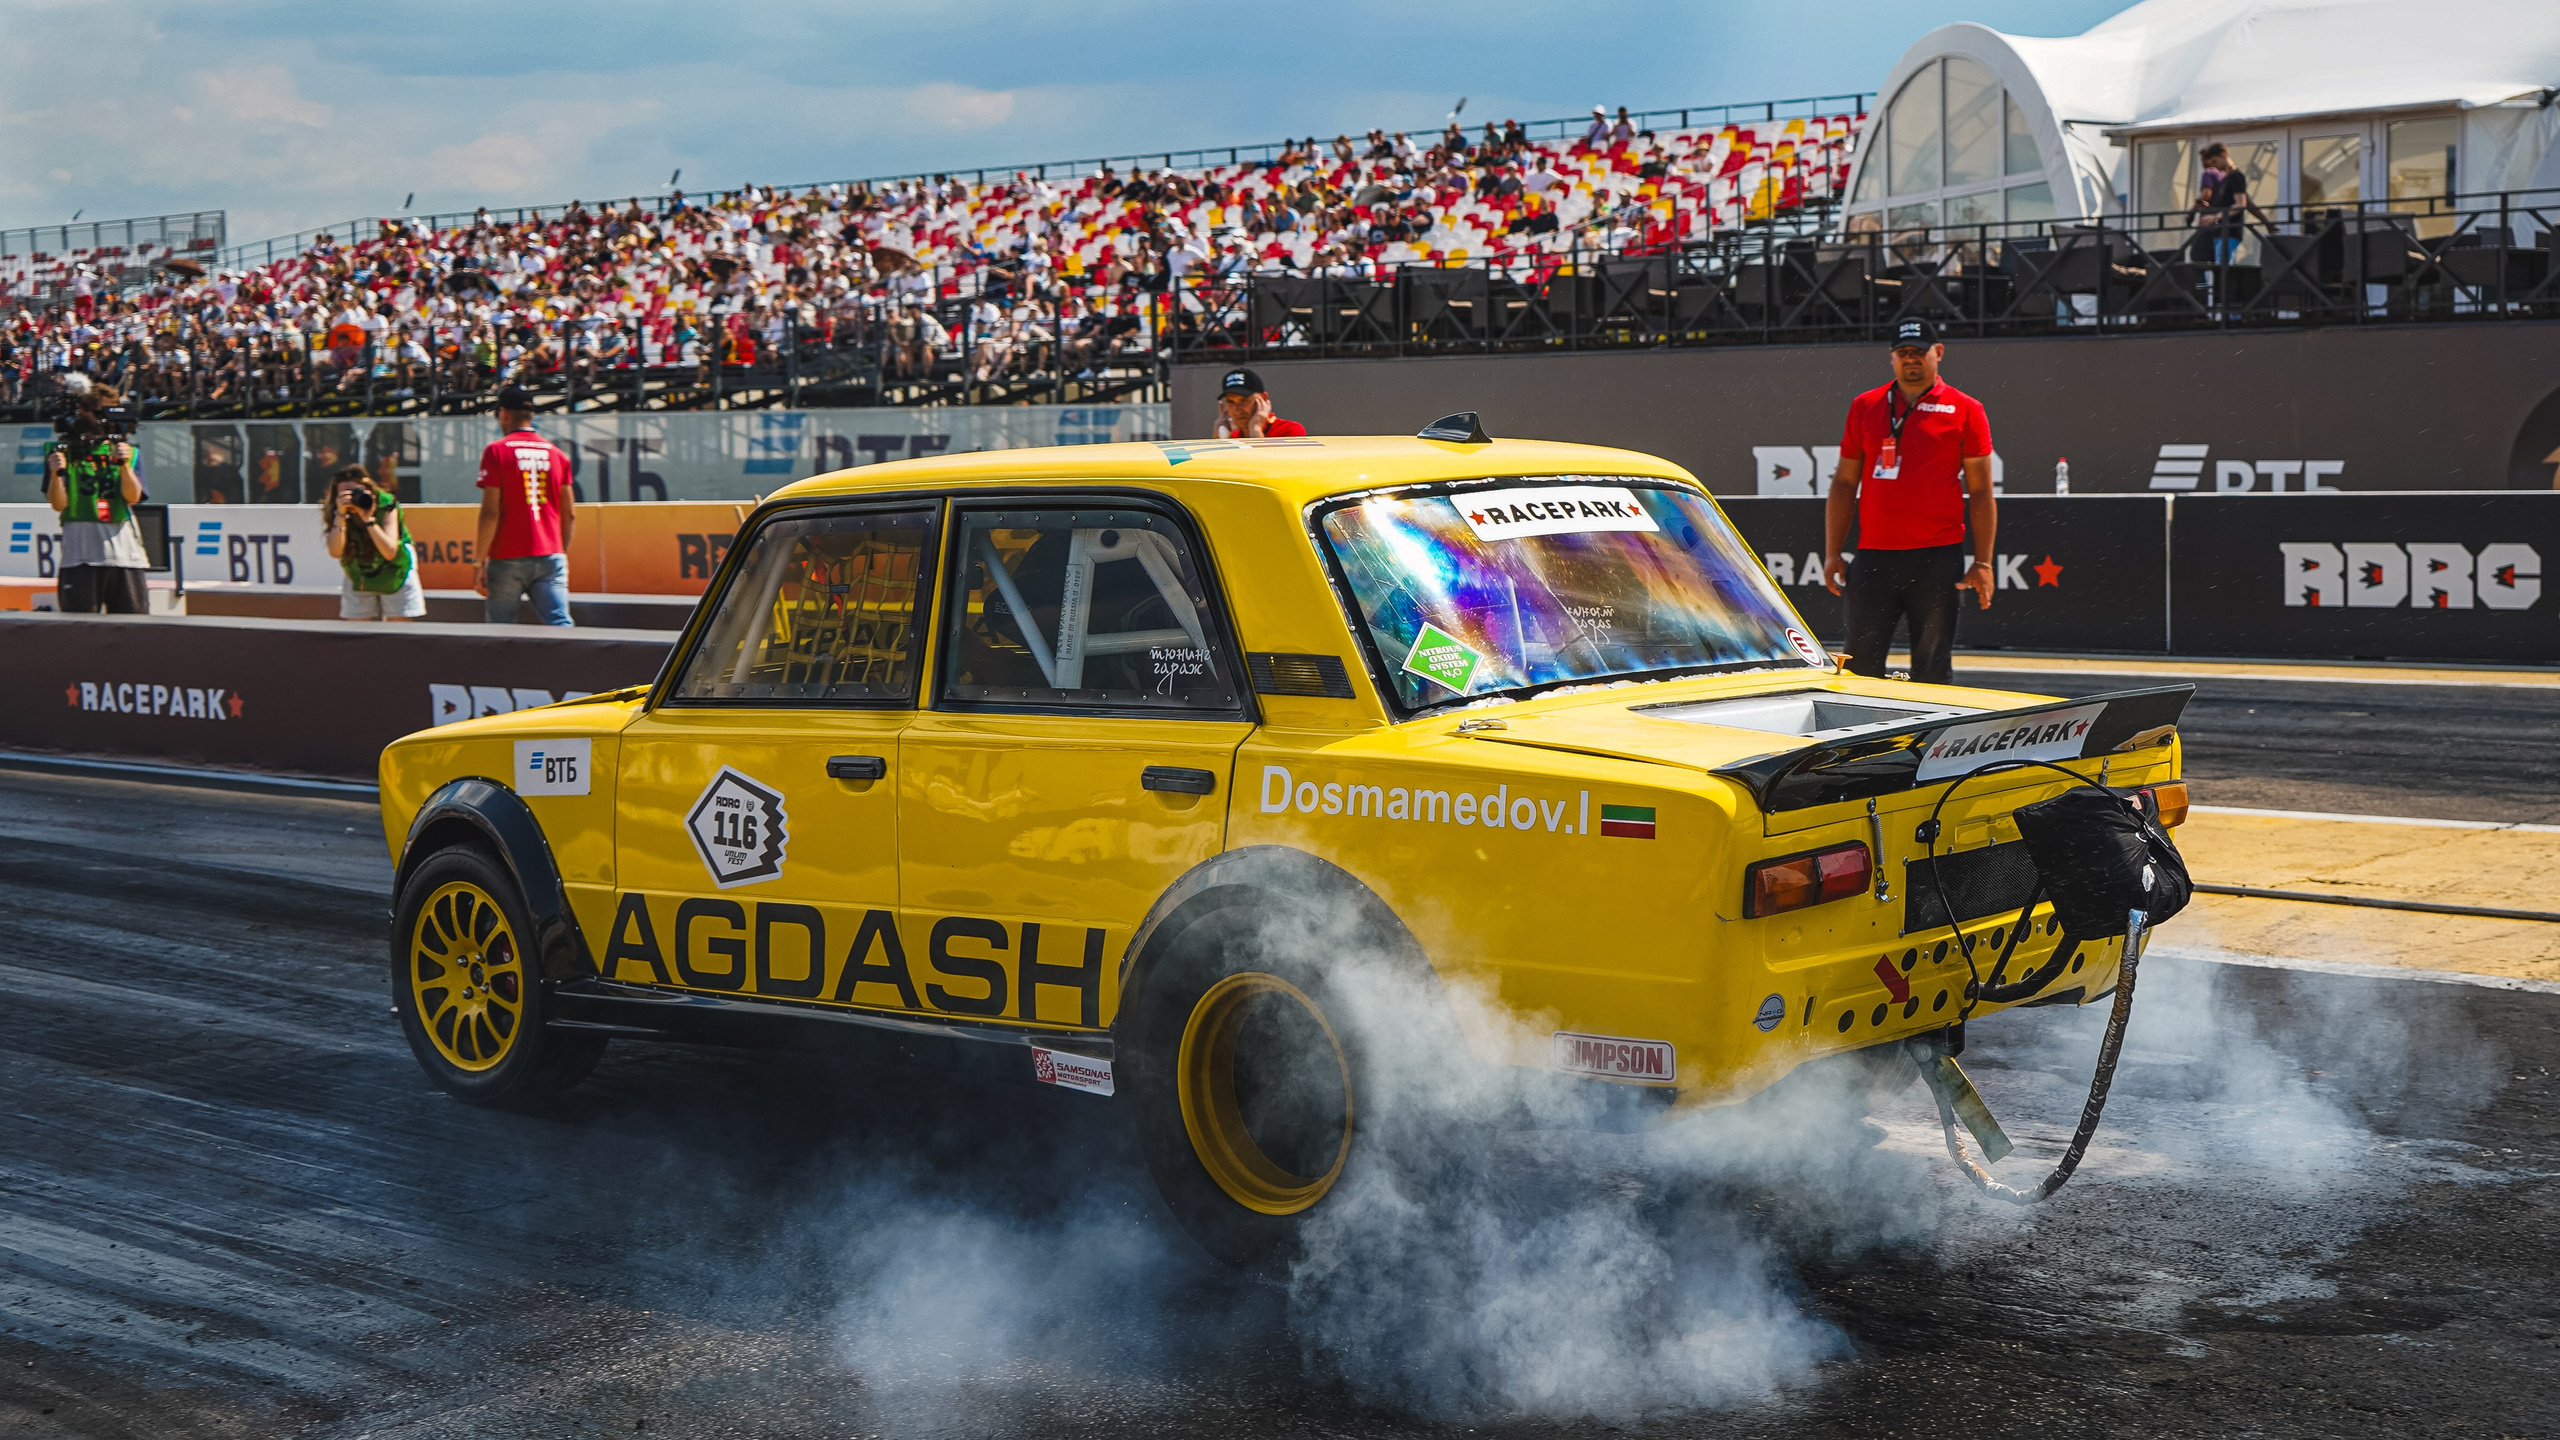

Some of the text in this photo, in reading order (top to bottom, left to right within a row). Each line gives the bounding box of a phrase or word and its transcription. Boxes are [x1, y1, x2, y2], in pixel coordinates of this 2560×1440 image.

[1483, 500, 1632, 525] RACEPARK
[228, 534, 293, 584] ВТБ
[2279, 542, 2541, 610] RDRC
[1149, 646, 1211, 662] тюнинг
[1417, 644, 1463, 658] NITROUS
[1428, 652, 1461, 663] OXIDE
[1428, 659, 1469, 672] SYSTEM
[1154, 662, 1203, 695] гараж
[81, 681, 226, 720] RACEPARK
[1943, 719, 2081, 759] RACEPARK
[546, 757, 577, 783] ВТБ
[716, 796, 740, 809] RDRC
[713, 810, 758, 850] 116
[727, 857, 745, 866] FEST
[601, 892, 1105, 1025] AGDASH
[1562, 1038, 1663, 1075] SIMPSON
[1057, 1063, 1111, 1081] SAMSONAS
[1057, 1072, 1101, 1086] MOTORSPORT
